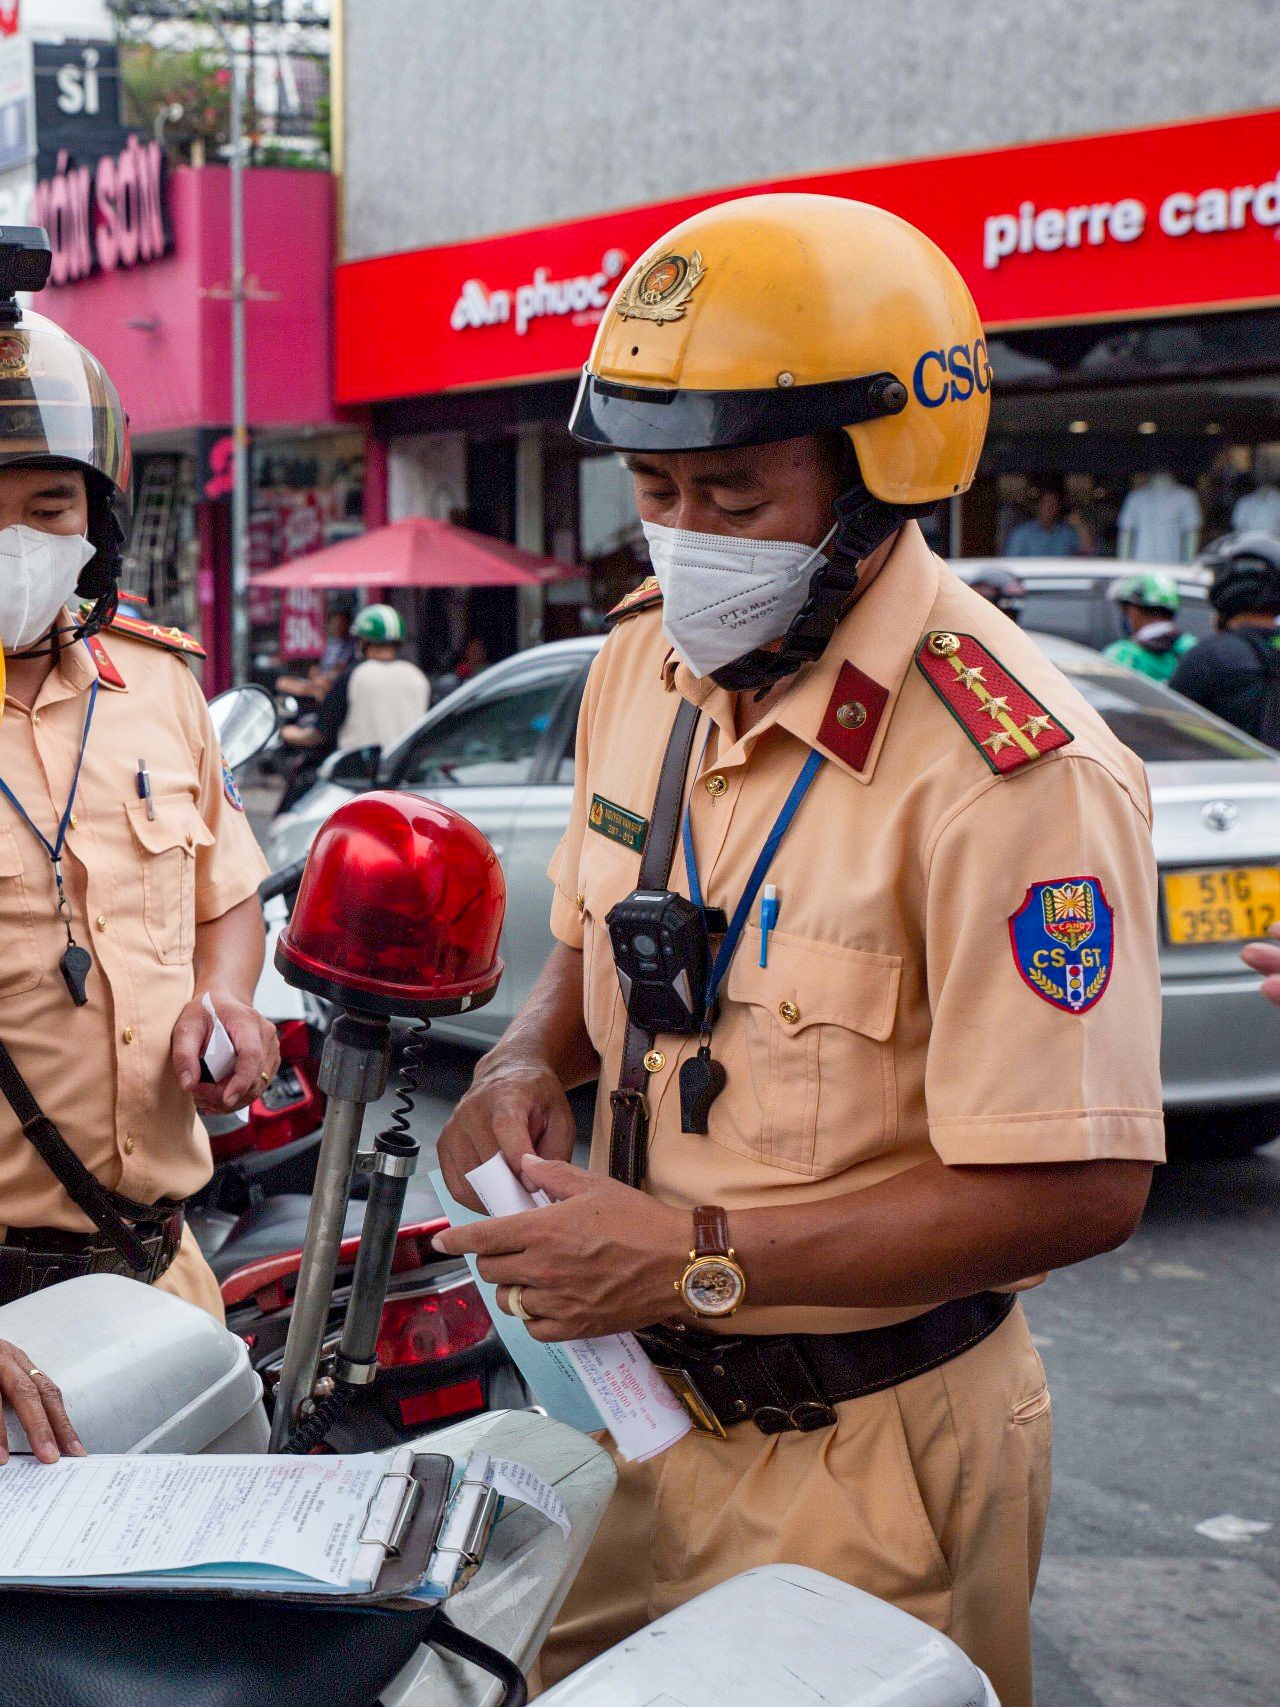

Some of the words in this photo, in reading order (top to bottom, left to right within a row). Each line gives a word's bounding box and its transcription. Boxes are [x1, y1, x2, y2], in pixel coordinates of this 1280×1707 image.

[983, 199, 1147, 270] pierre
[1033, 948, 1066, 968] CS
[1080, 948, 1102, 968] GT
